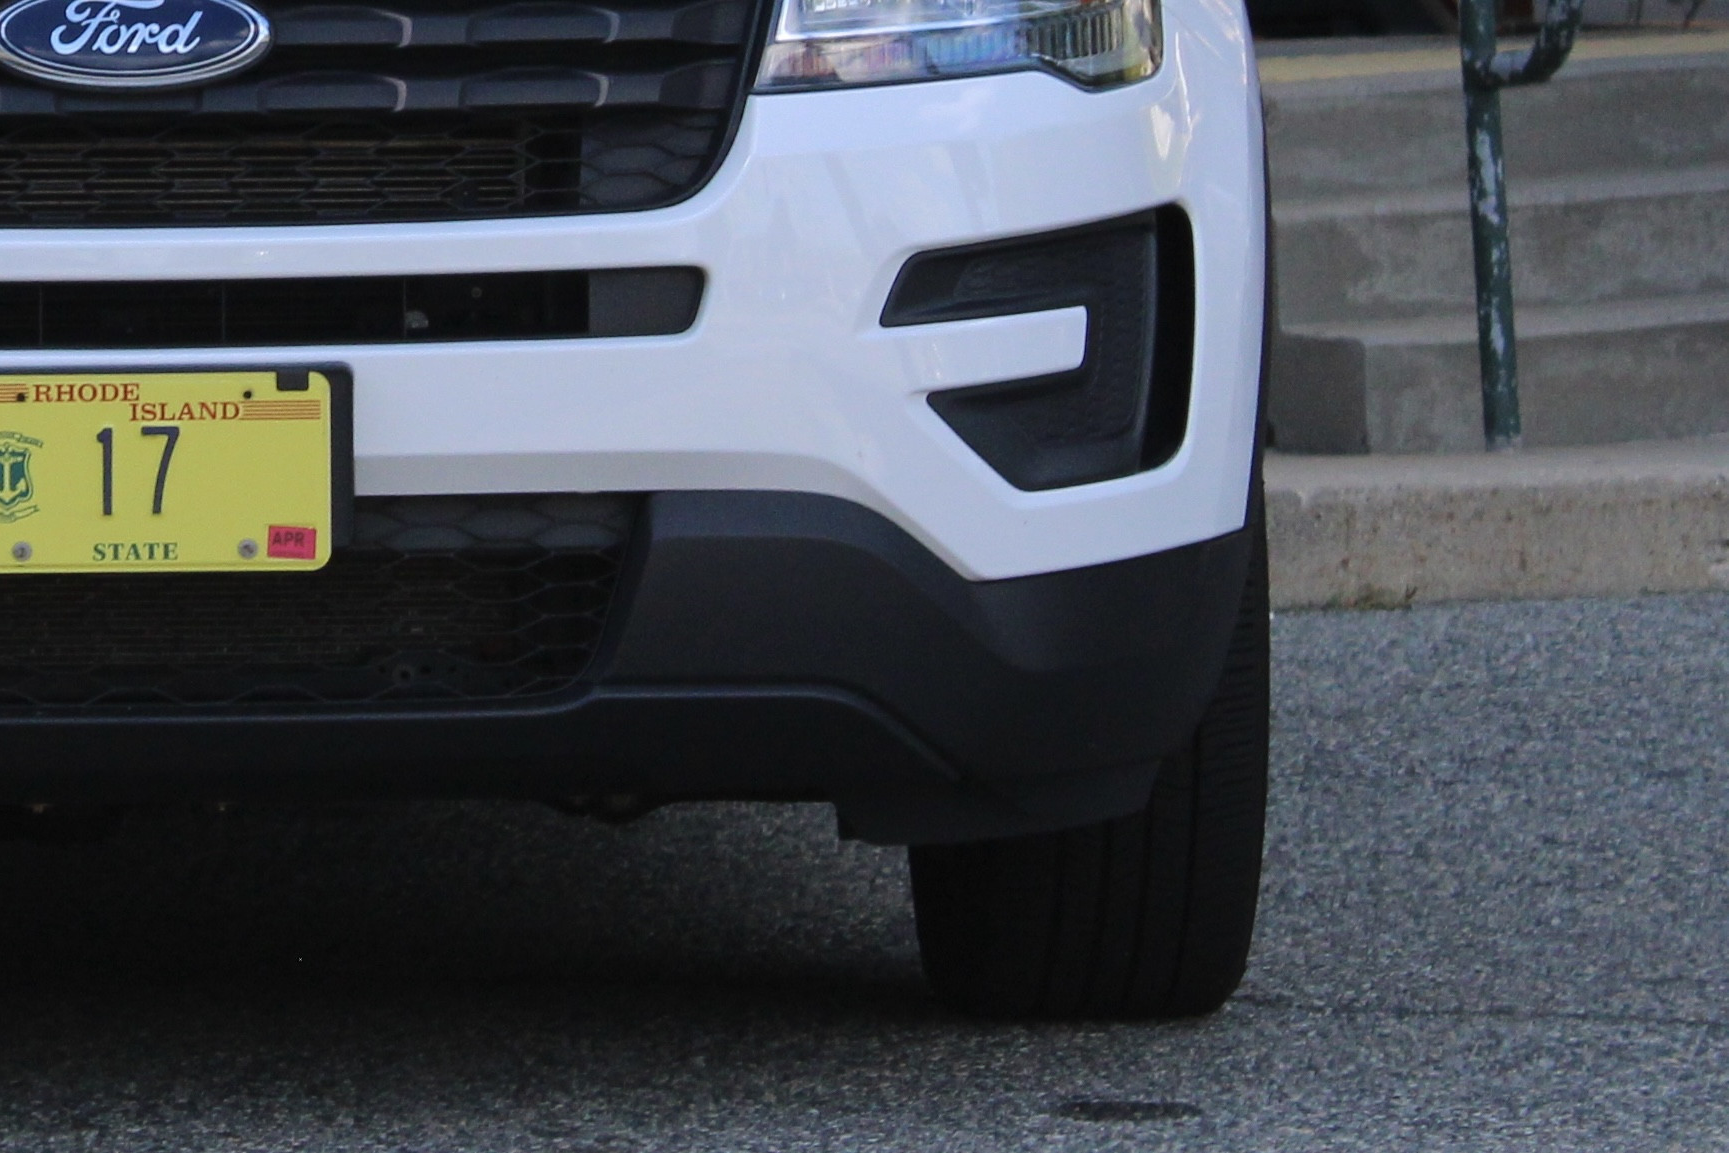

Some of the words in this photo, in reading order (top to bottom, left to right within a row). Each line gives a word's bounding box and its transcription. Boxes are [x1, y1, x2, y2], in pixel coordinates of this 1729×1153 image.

[32, 383, 140, 403] RHODE
[129, 401, 240, 421] ISLAND
[96, 426, 180, 516] 17
[272, 531, 304, 548] APR
[92, 542, 179, 561] STATE
